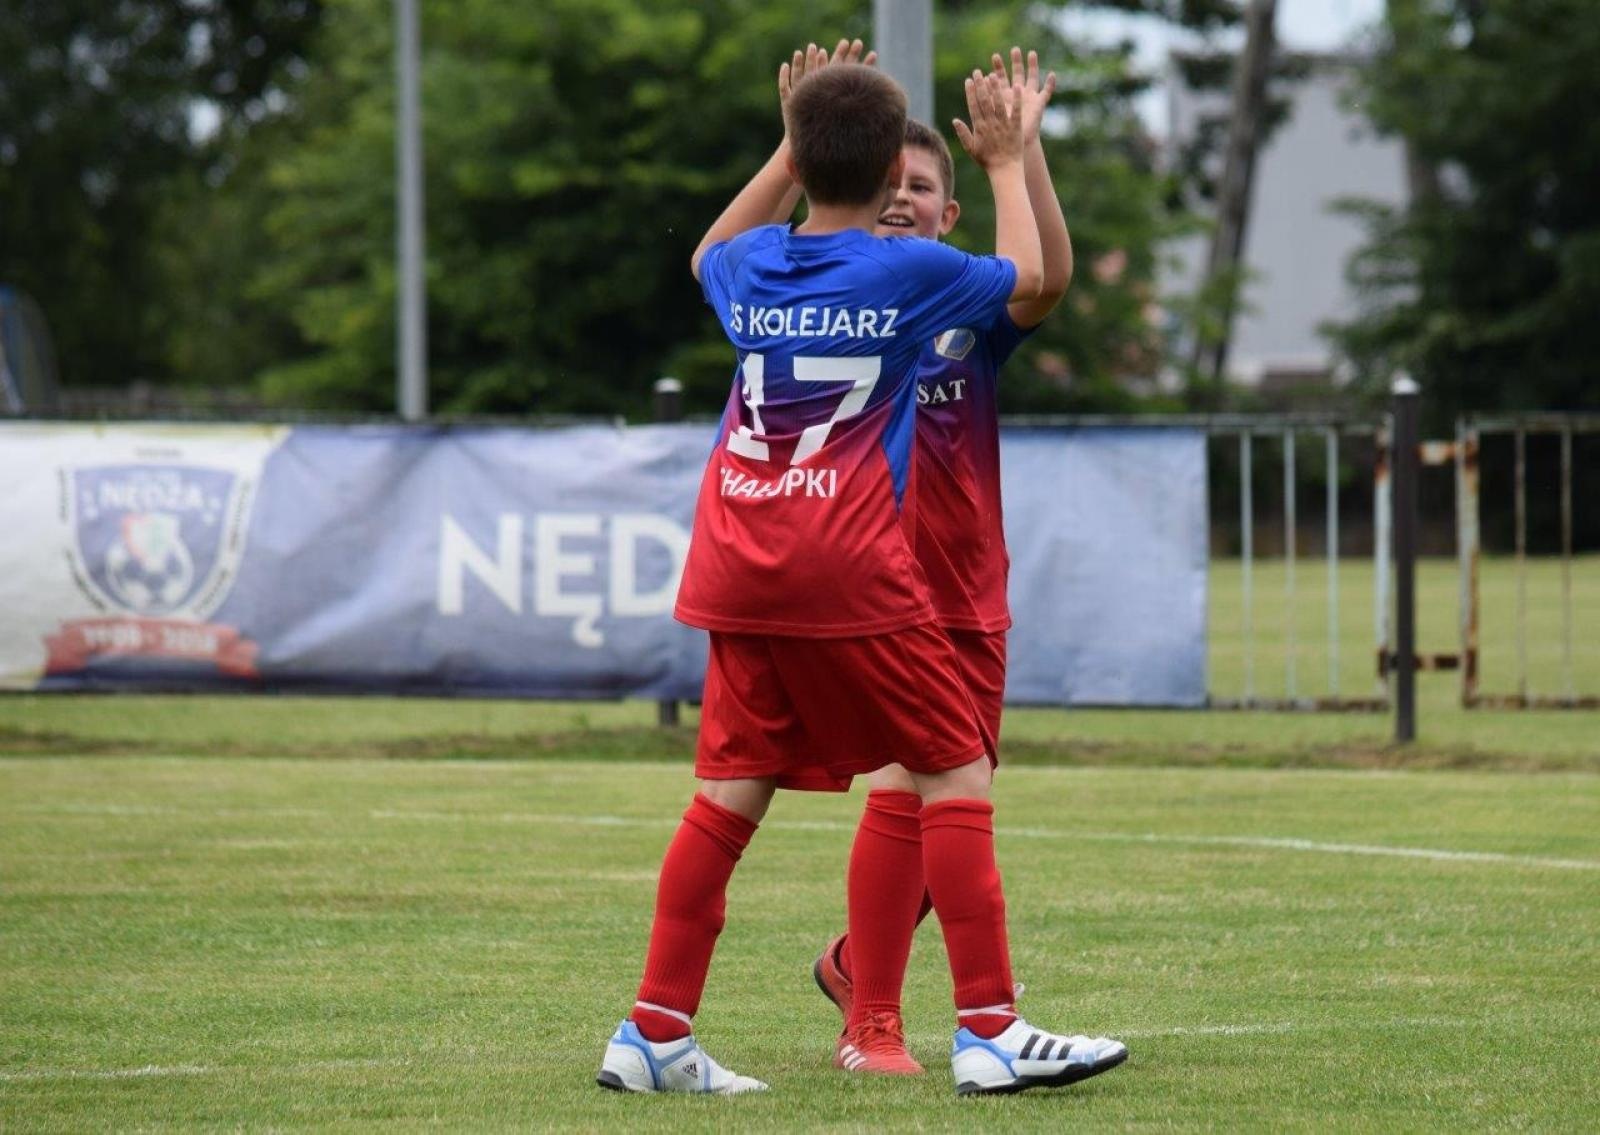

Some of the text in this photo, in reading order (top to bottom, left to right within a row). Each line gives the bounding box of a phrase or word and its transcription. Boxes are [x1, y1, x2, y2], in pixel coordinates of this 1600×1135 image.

[750, 306, 898, 338] KOLEJARZ
[917, 379, 966, 405] SAT
[726, 353, 882, 466] 17
